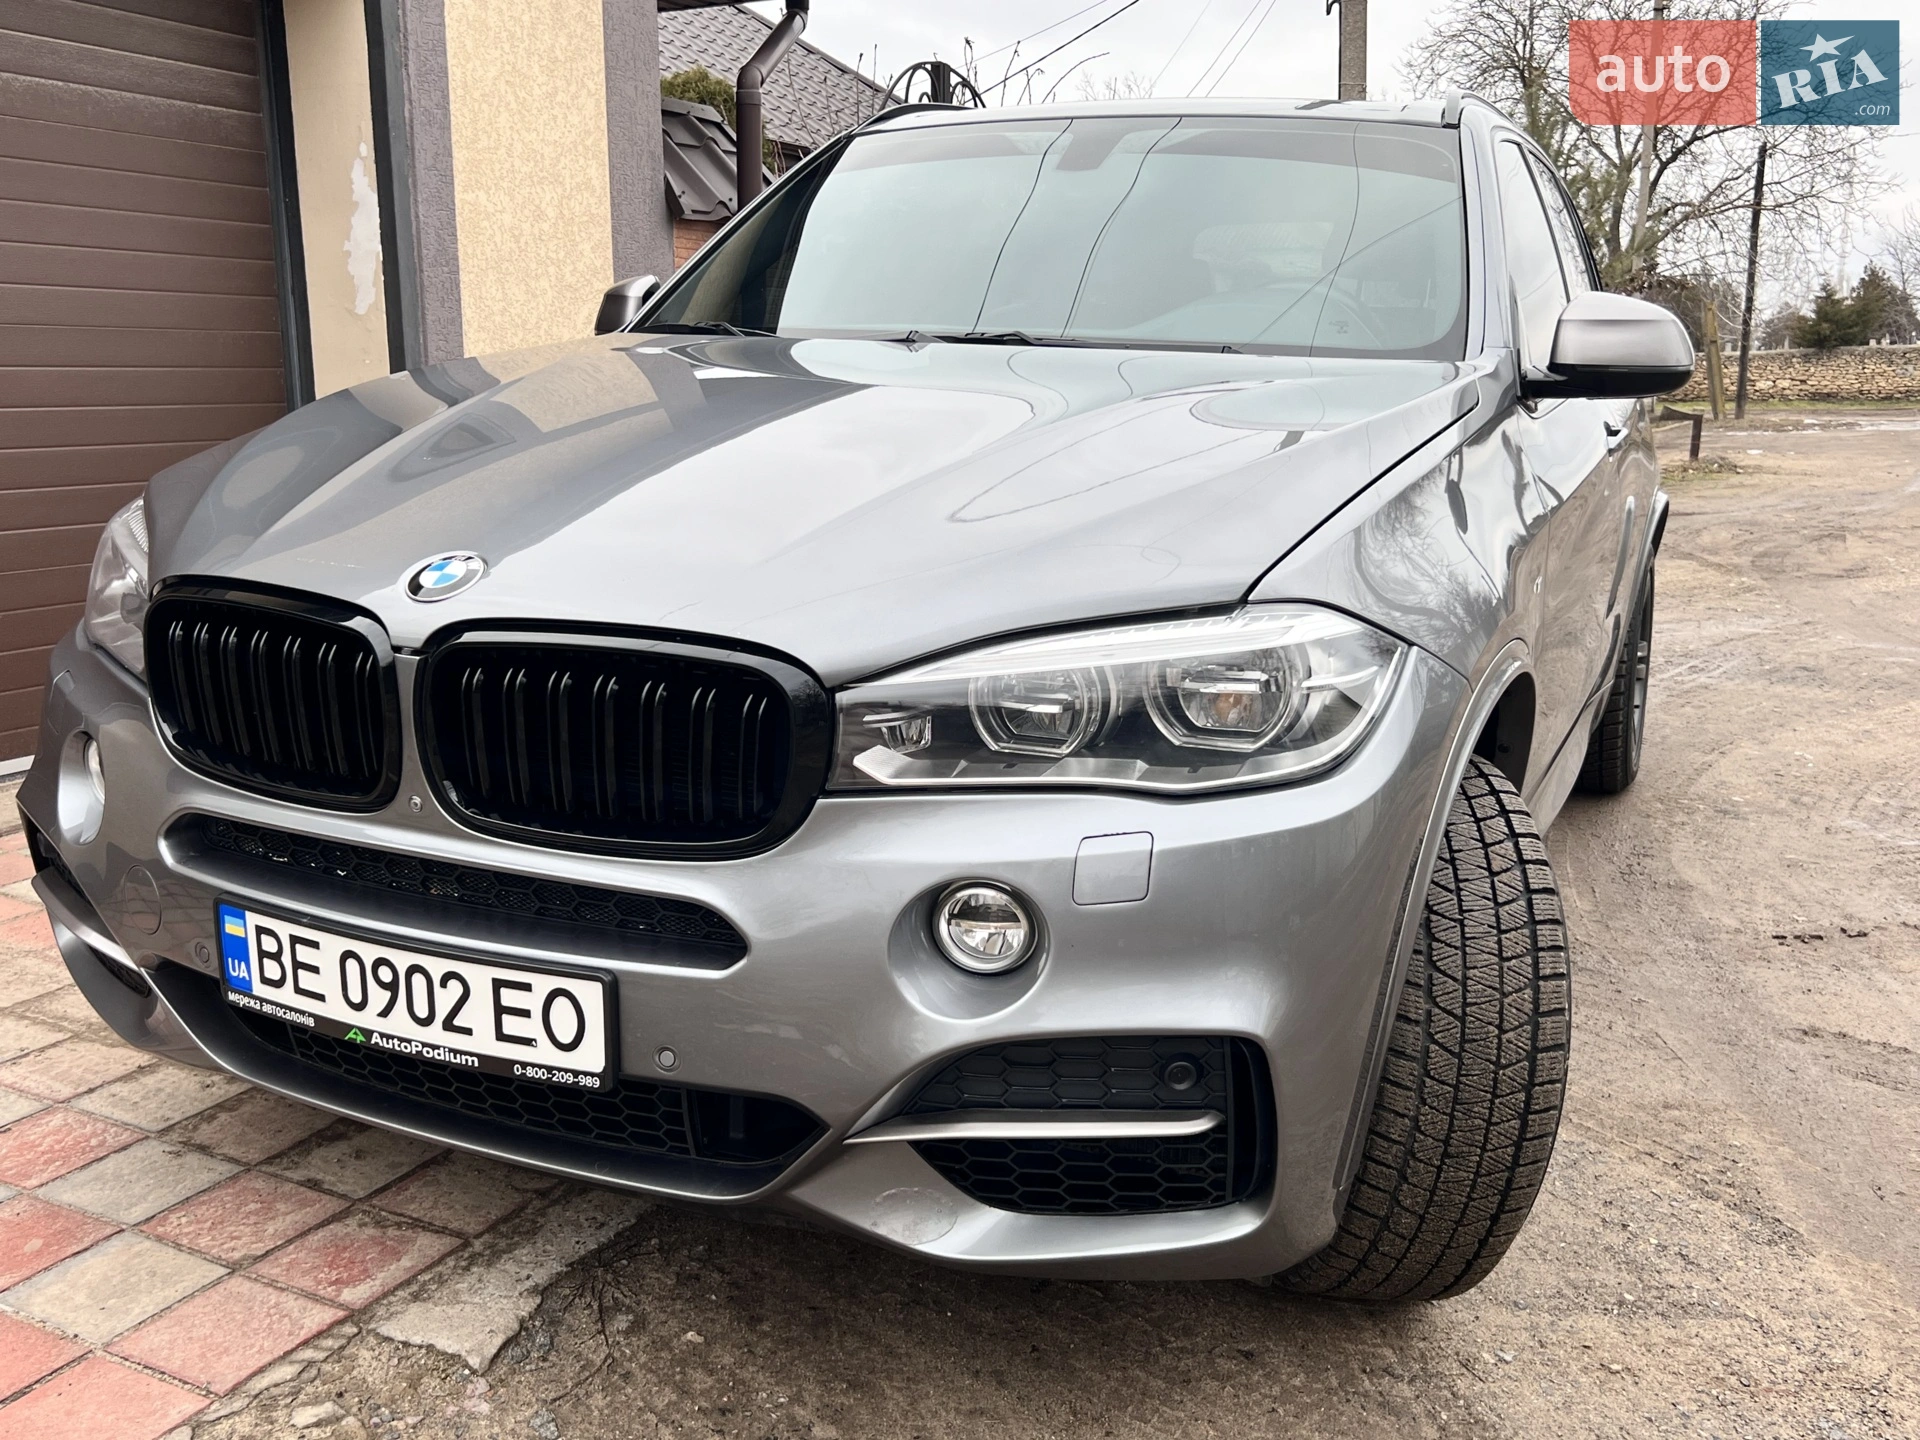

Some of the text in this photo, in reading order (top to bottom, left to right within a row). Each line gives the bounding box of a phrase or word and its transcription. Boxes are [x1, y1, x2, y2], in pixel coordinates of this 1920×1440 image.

[228, 957, 249, 981] UA
[254, 924, 586, 1052] BE 0902 EO
[228, 990, 315, 1027] мережа автосалонів
[370, 1032, 479, 1068] AutoPodium
[513, 1064, 601, 1088] 0-800-209-989
